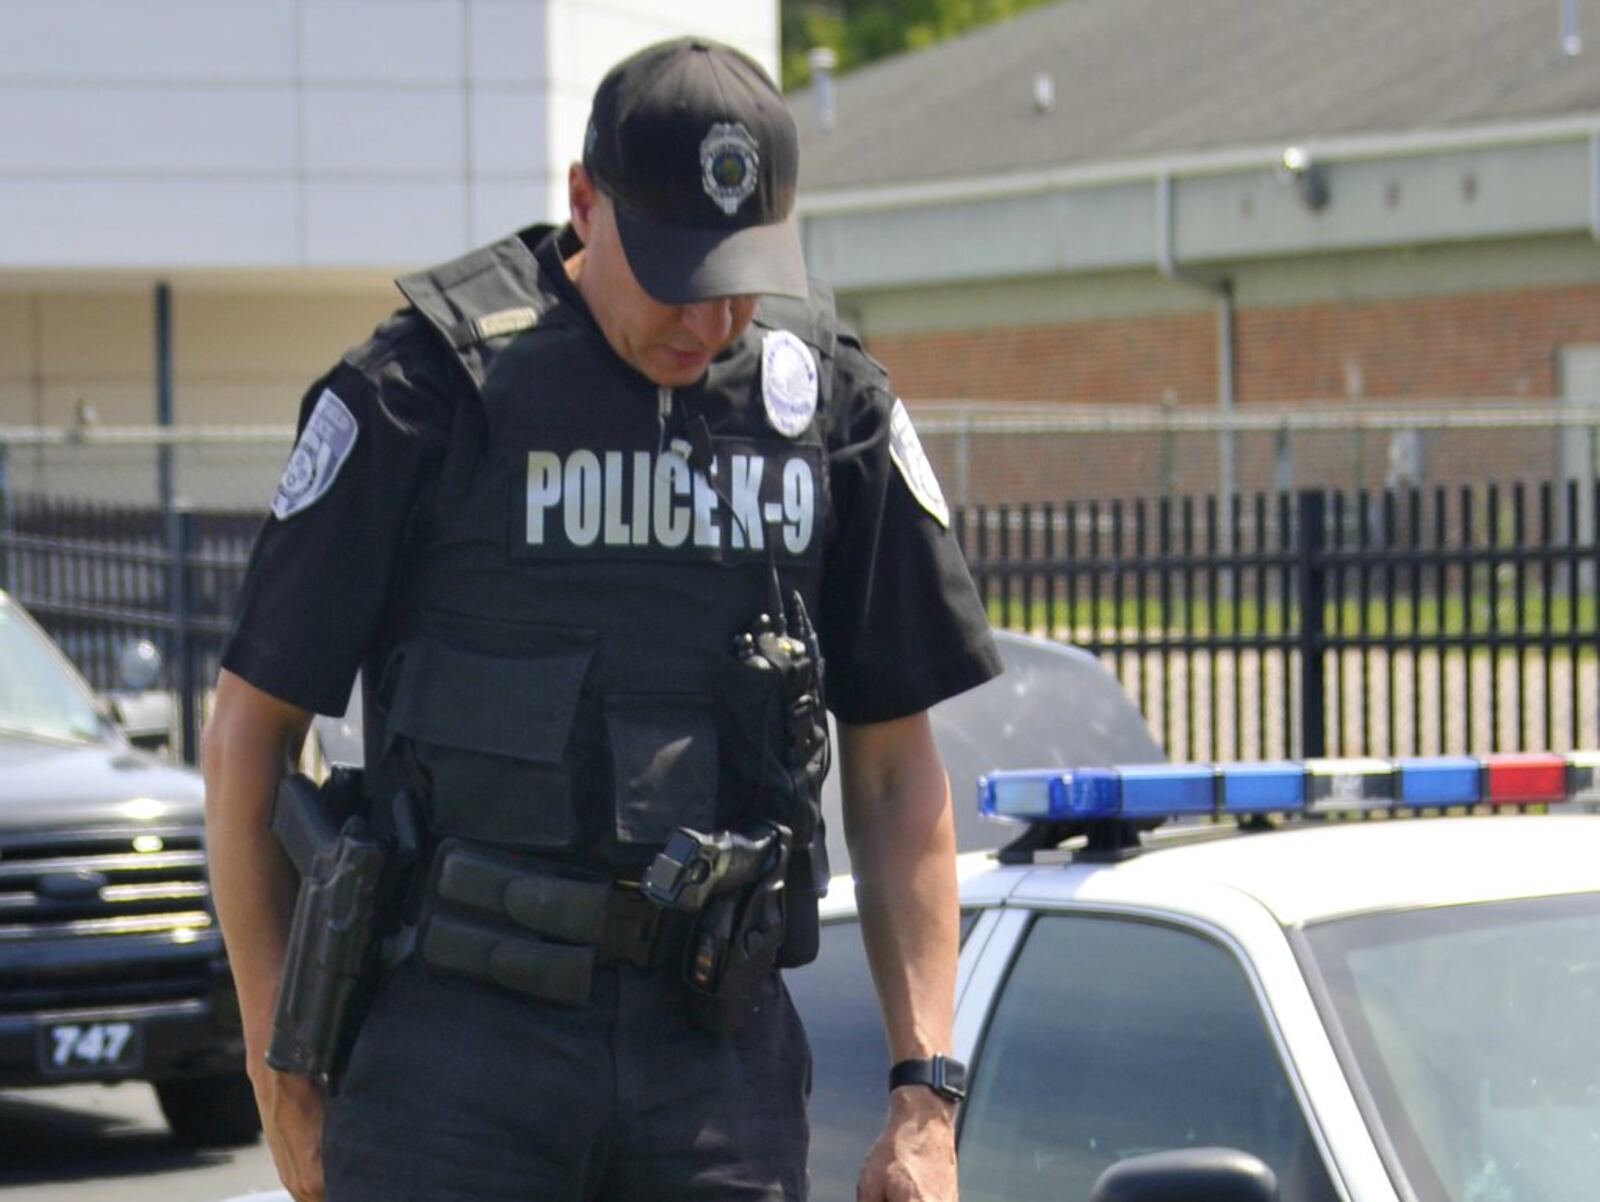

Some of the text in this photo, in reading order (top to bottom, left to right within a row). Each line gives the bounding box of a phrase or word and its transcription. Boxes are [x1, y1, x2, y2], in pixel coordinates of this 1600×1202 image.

[526, 449, 814, 553] POLICE K-9
[51, 1022, 132, 1066] 747
